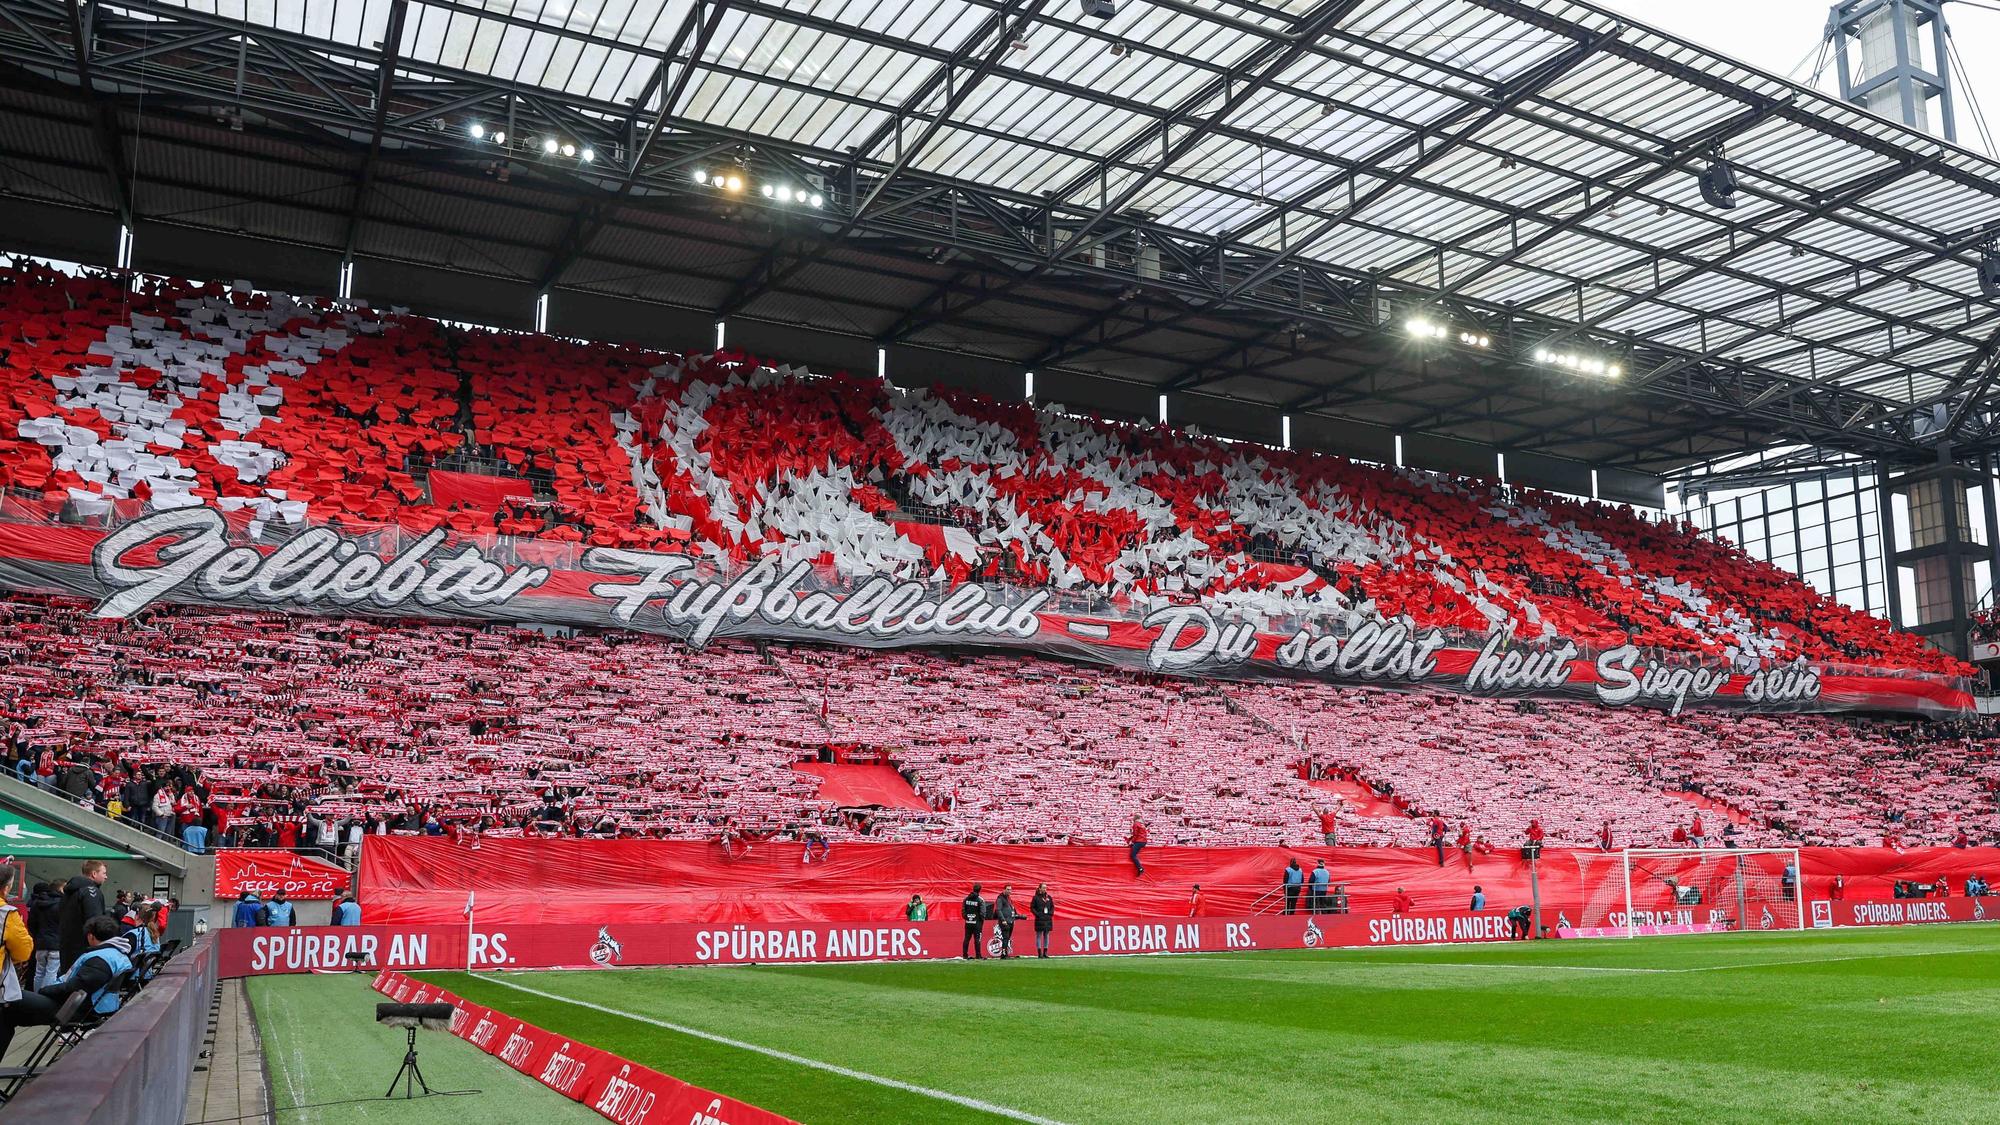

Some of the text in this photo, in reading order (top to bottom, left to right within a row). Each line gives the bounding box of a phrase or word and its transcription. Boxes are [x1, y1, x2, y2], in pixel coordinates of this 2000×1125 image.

[91, 505, 550, 618] Geliebter
[581, 548, 1050, 649] Fußballclub
[1142, 605, 1257, 672] Du
[1276, 621, 1446, 681] sollst
[1465, 629, 1577, 691] heut
[1595, 645, 1729, 715] Sieger
[1745, 663, 1822, 704] sein
[233, 880, 333, 892] JECK OP FC
[1369, 914, 1448, 943] SPÜRBAR
[1853, 900, 1950, 924] SPÜRBAR ANDERS.
[251, 929, 378, 970] SPÜRBAR
[695, 925, 928, 960] SPÜRBAR ANDERS.
[1070, 920, 1168, 952] SPÜRBAR
[540, 1051, 586, 1093] DERTOUR
[596, 1076, 656, 1125] DERTOUR
